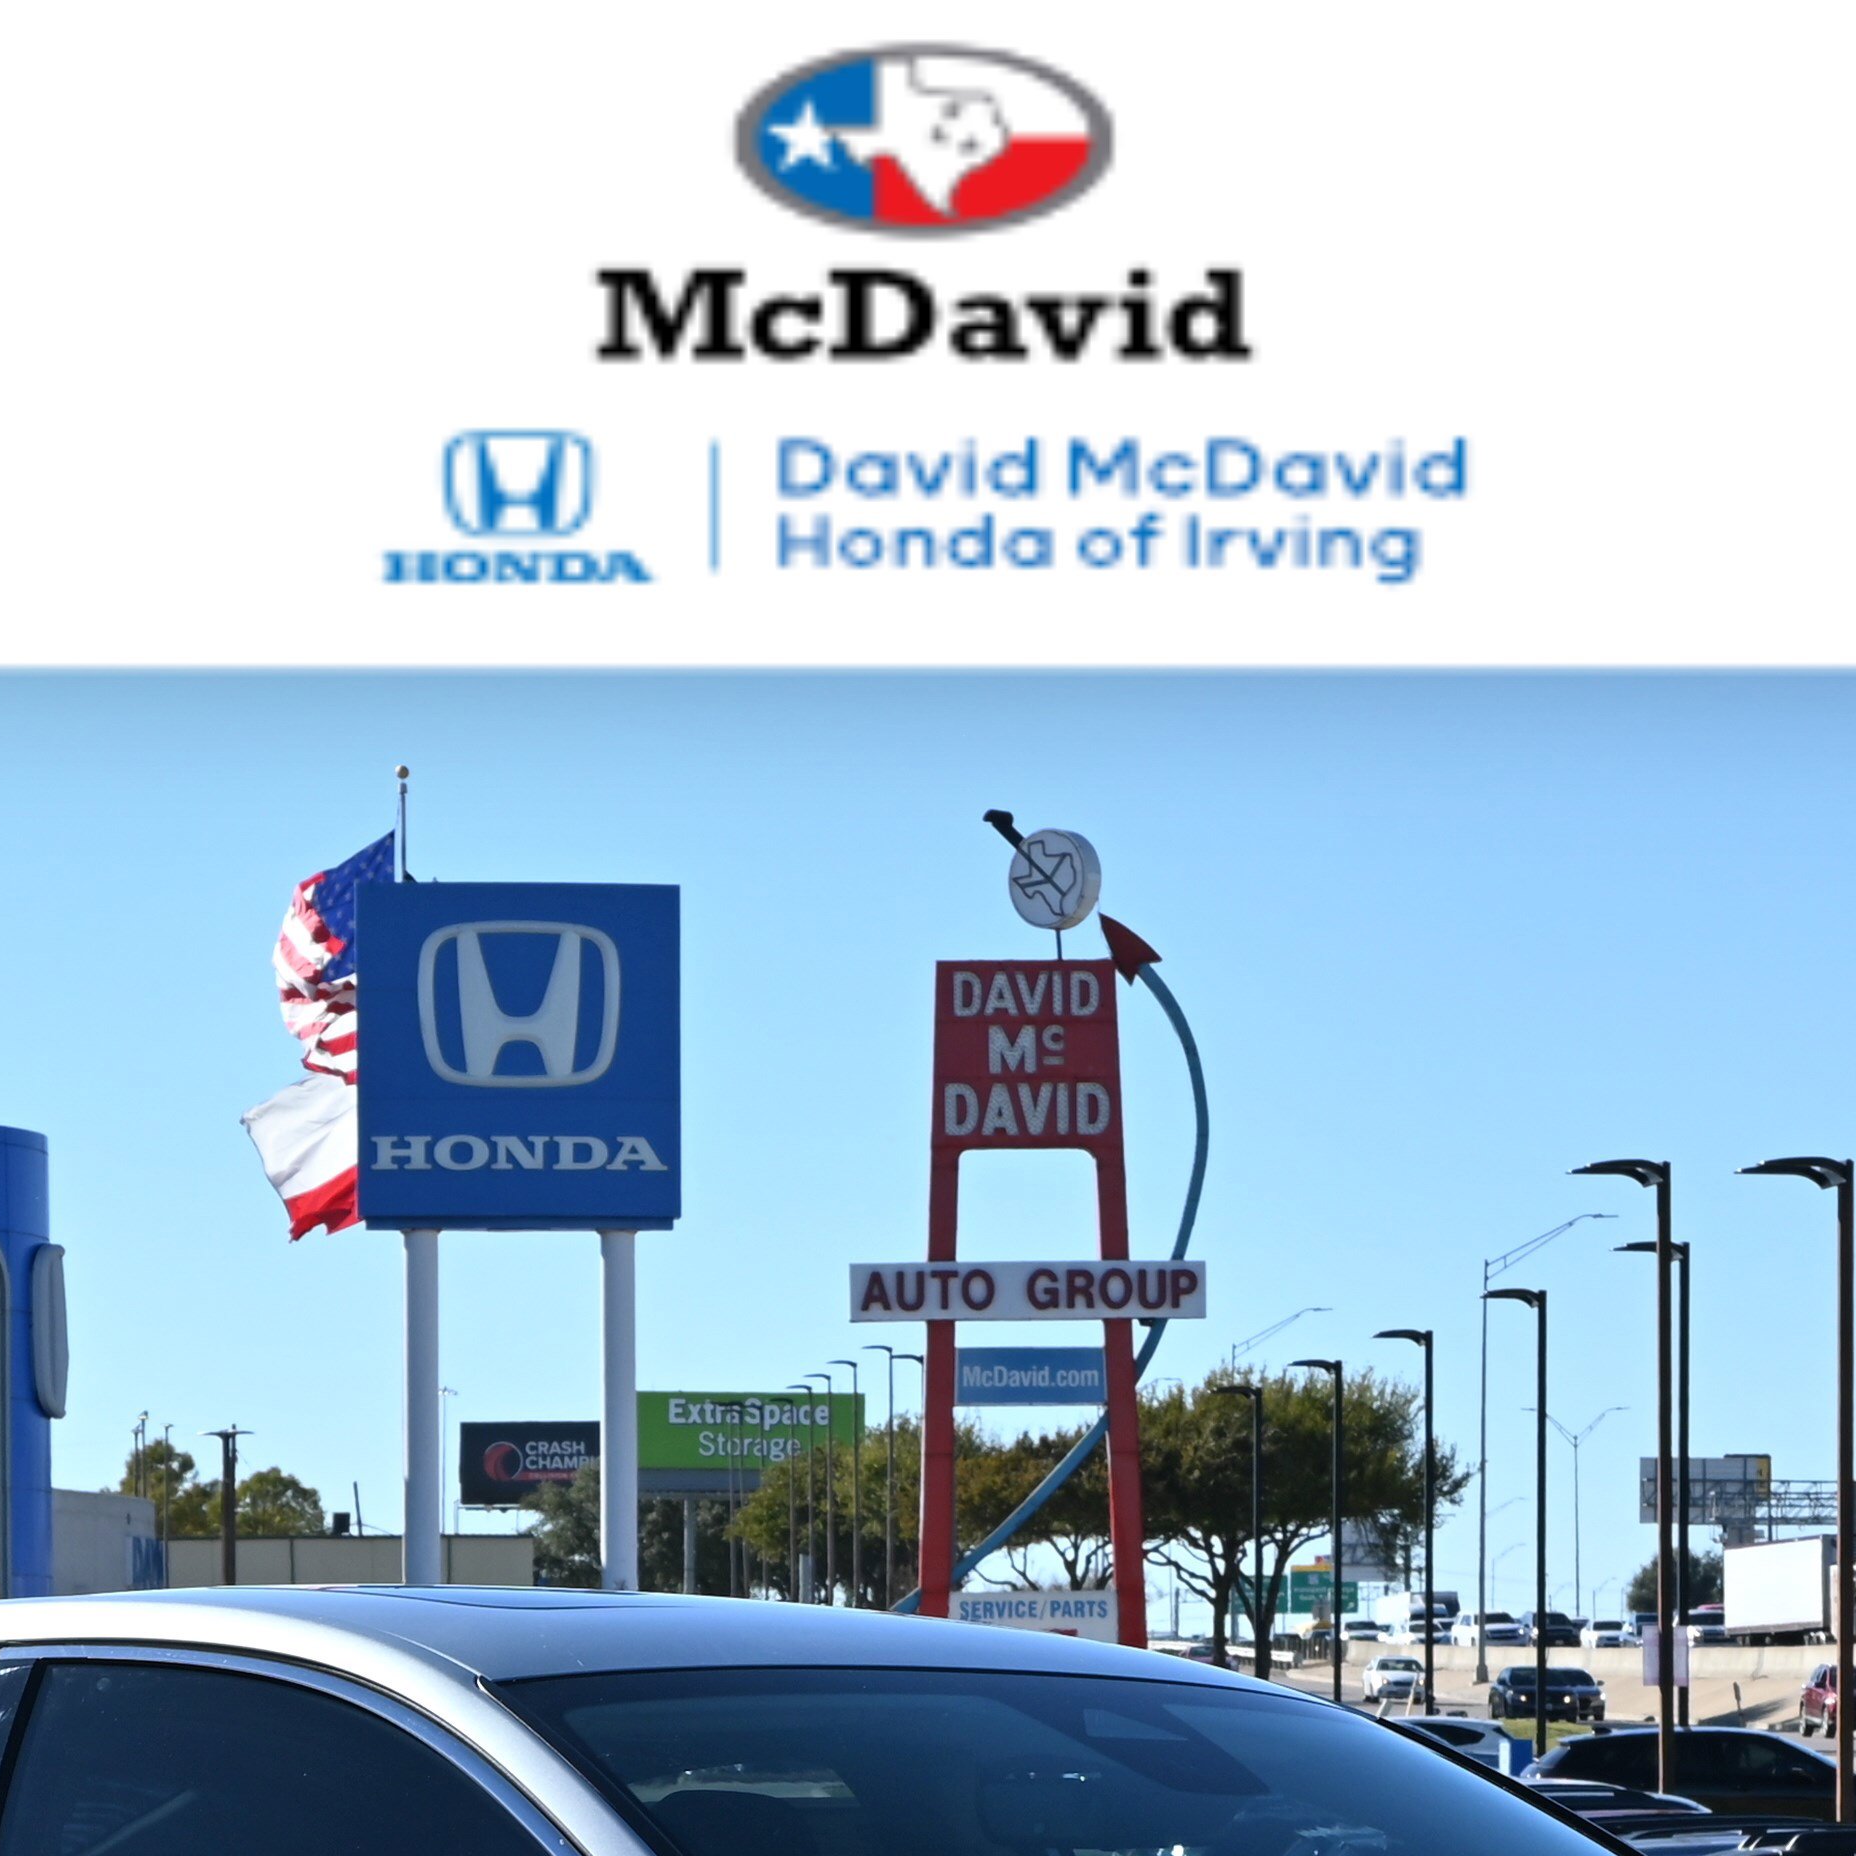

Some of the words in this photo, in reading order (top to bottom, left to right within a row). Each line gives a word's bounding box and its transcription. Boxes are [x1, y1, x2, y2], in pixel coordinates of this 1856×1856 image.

[952, 970, 1100, 1018] DAVID
[988, 1024, 1065, 1074] Mc
[944, 1081, 1111, 1137] DAVID
[370, 1134, 668, 1172] HONDA
[860, 1270, 996, 1312] AUTO
[1025, 1268, 1198, 1310] GROUP
[962, 1365, 1100, 1388] McDavid.com
[525, 1441, 586, 1455] CRASH
[698, 1431, 802, 1460] Storage
[959, 1599, 1108, 1620] SERVICE/PARTS
